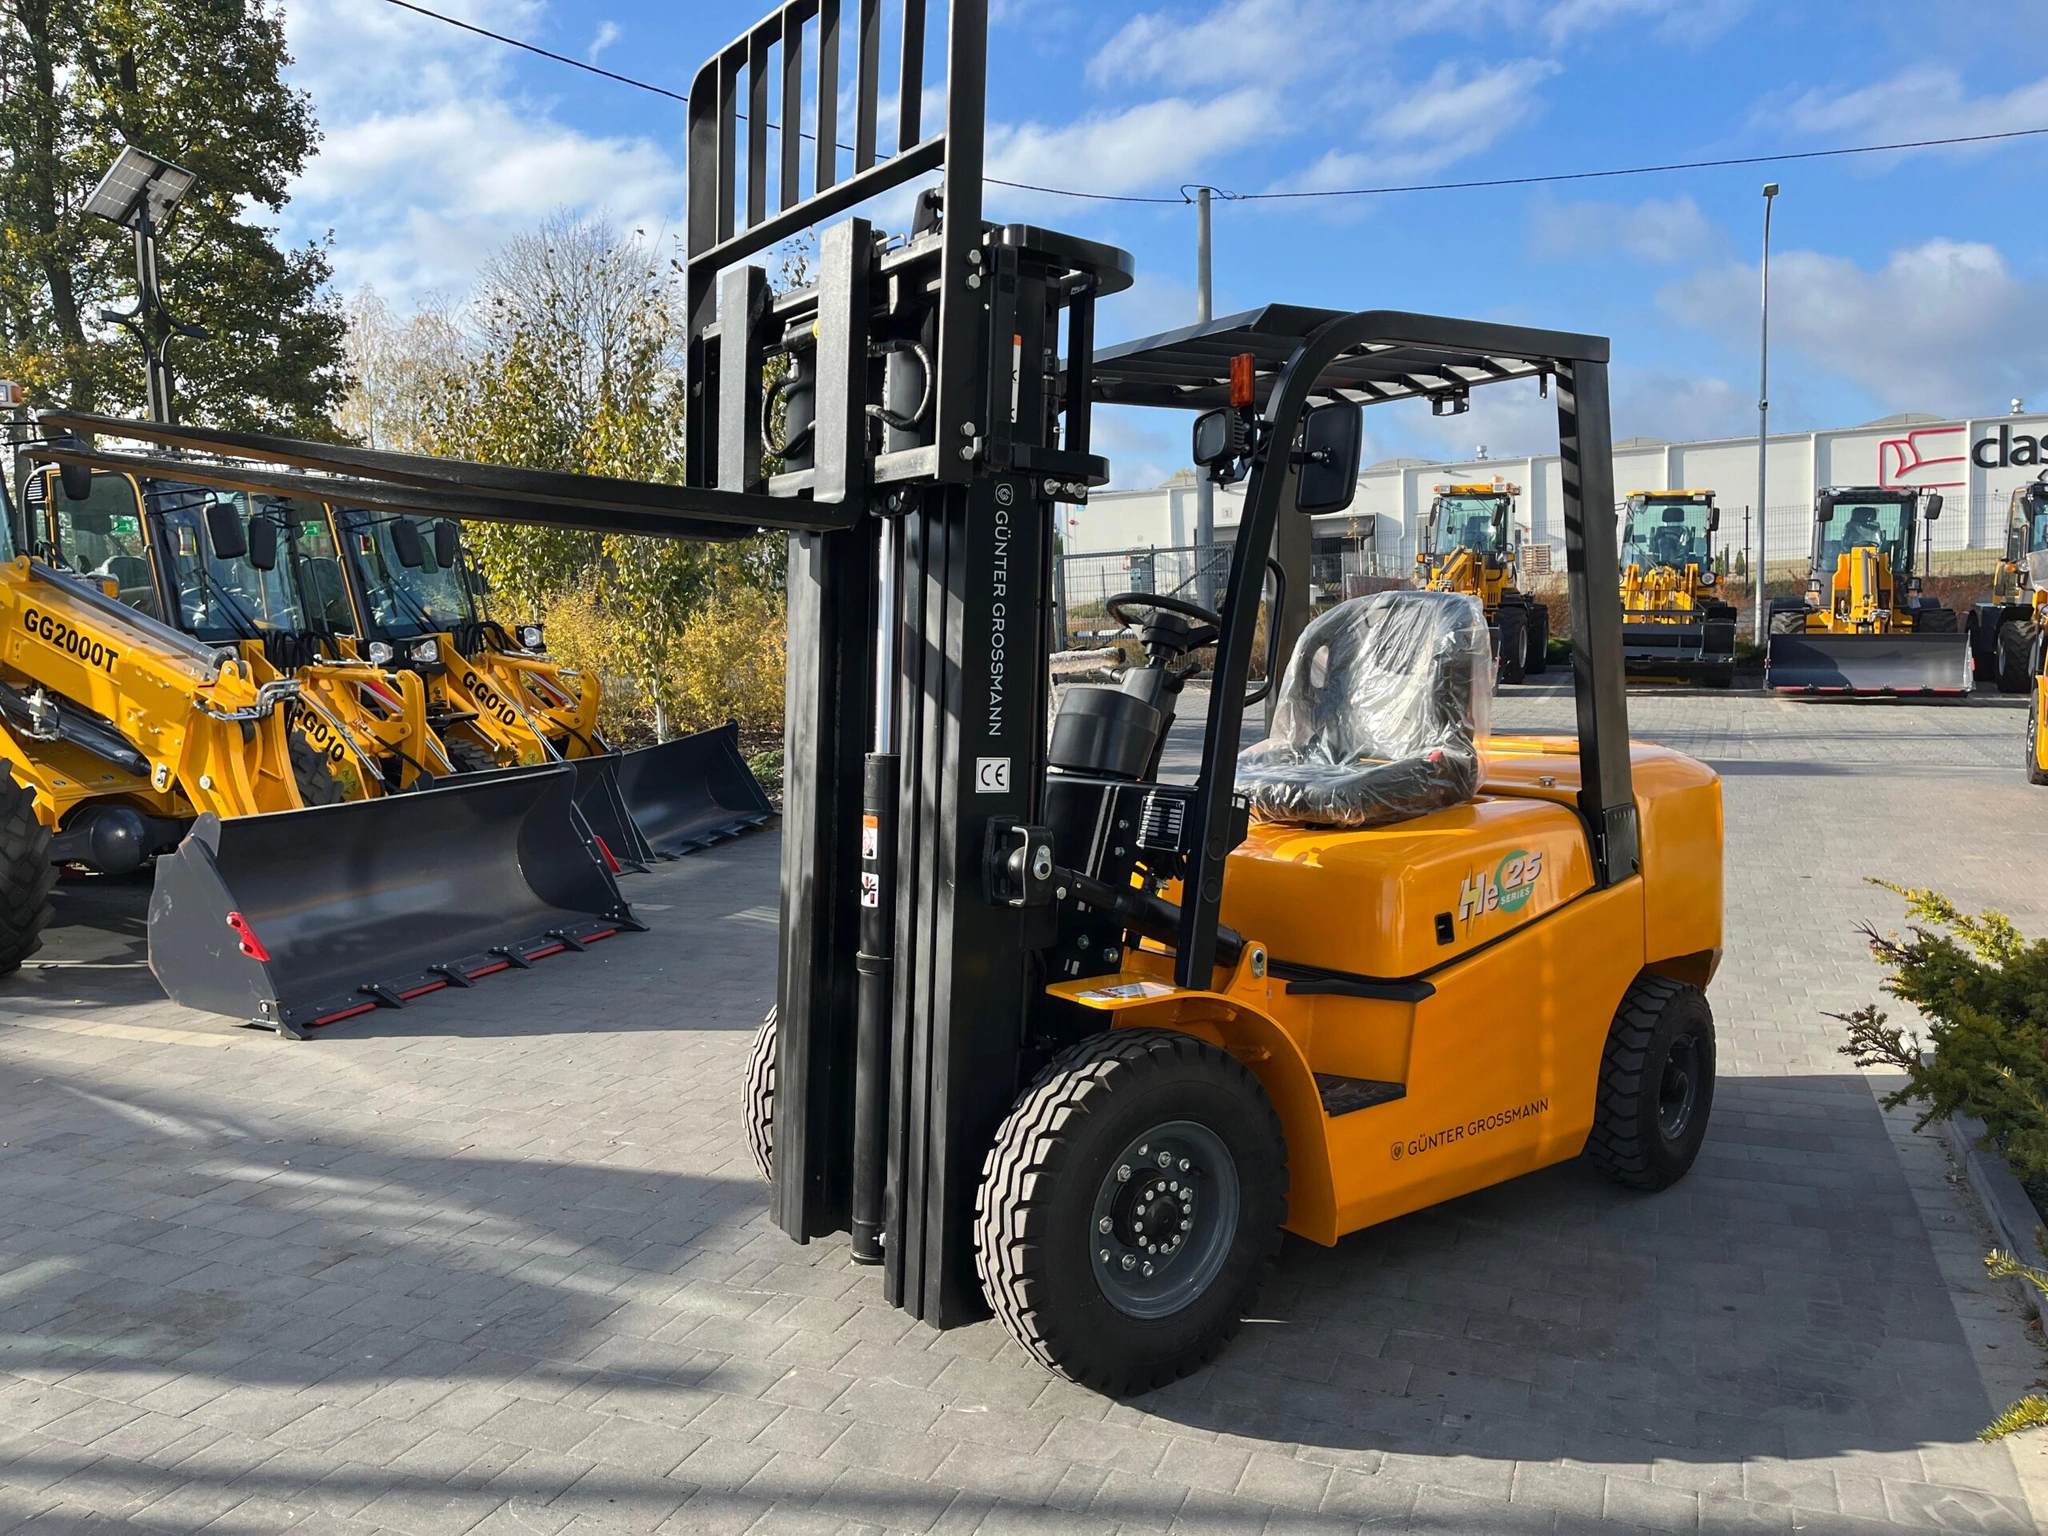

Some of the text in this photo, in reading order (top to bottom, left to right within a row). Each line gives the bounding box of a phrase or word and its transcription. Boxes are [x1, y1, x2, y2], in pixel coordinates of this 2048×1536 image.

[24, 608, 119, 674] GG2000T
[988, 510, 1011, 736] GÜNTER GROSSMANN
[463, 671, 516, 726] GG010
[981, 763, 1006, 787] CE
[1500, 887, 1531, 905] SERIES
[1506, 852, 1542, 890] 25
[1408, 1098, 1549, 1156] GÜNTER GROSSMANN
